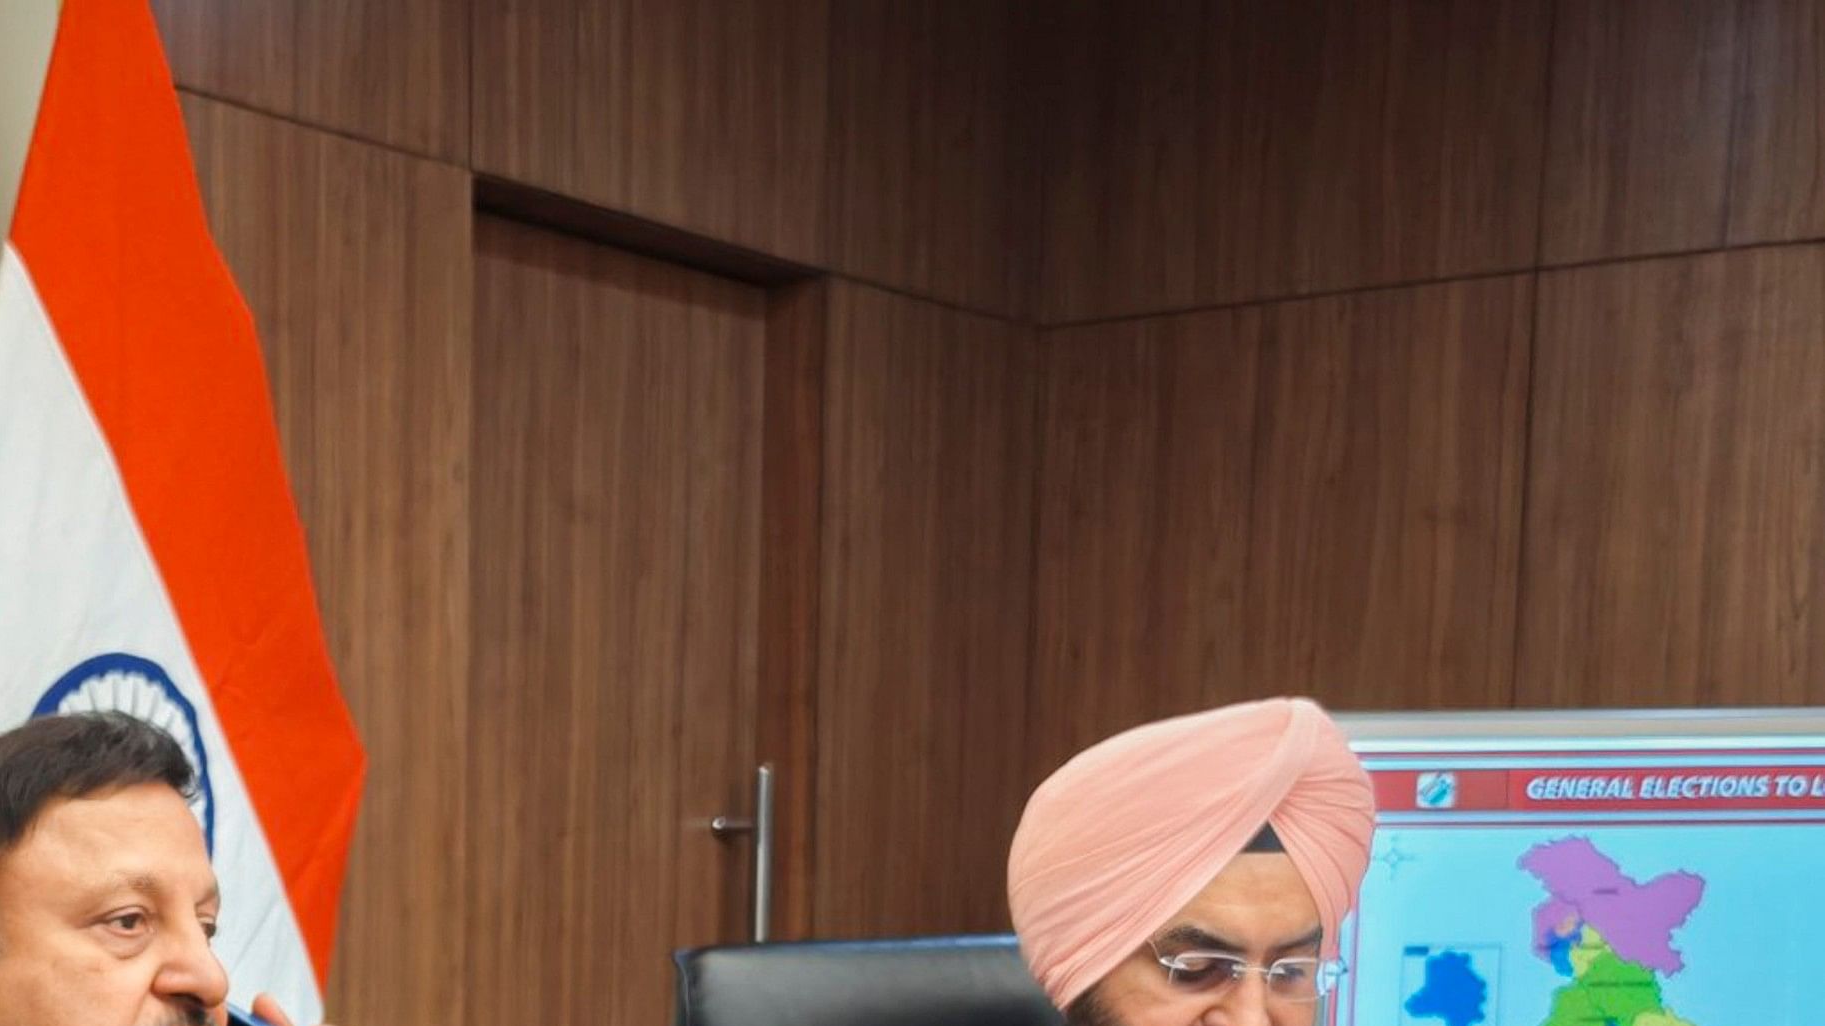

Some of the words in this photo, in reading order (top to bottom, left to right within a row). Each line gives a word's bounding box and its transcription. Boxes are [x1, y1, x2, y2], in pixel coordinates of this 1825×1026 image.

[1525, 775, 1634, 799] GENERAL
[1638, 774, 1771, 799] ELECTIONS
[1774, 775, 1808, 798] TO
